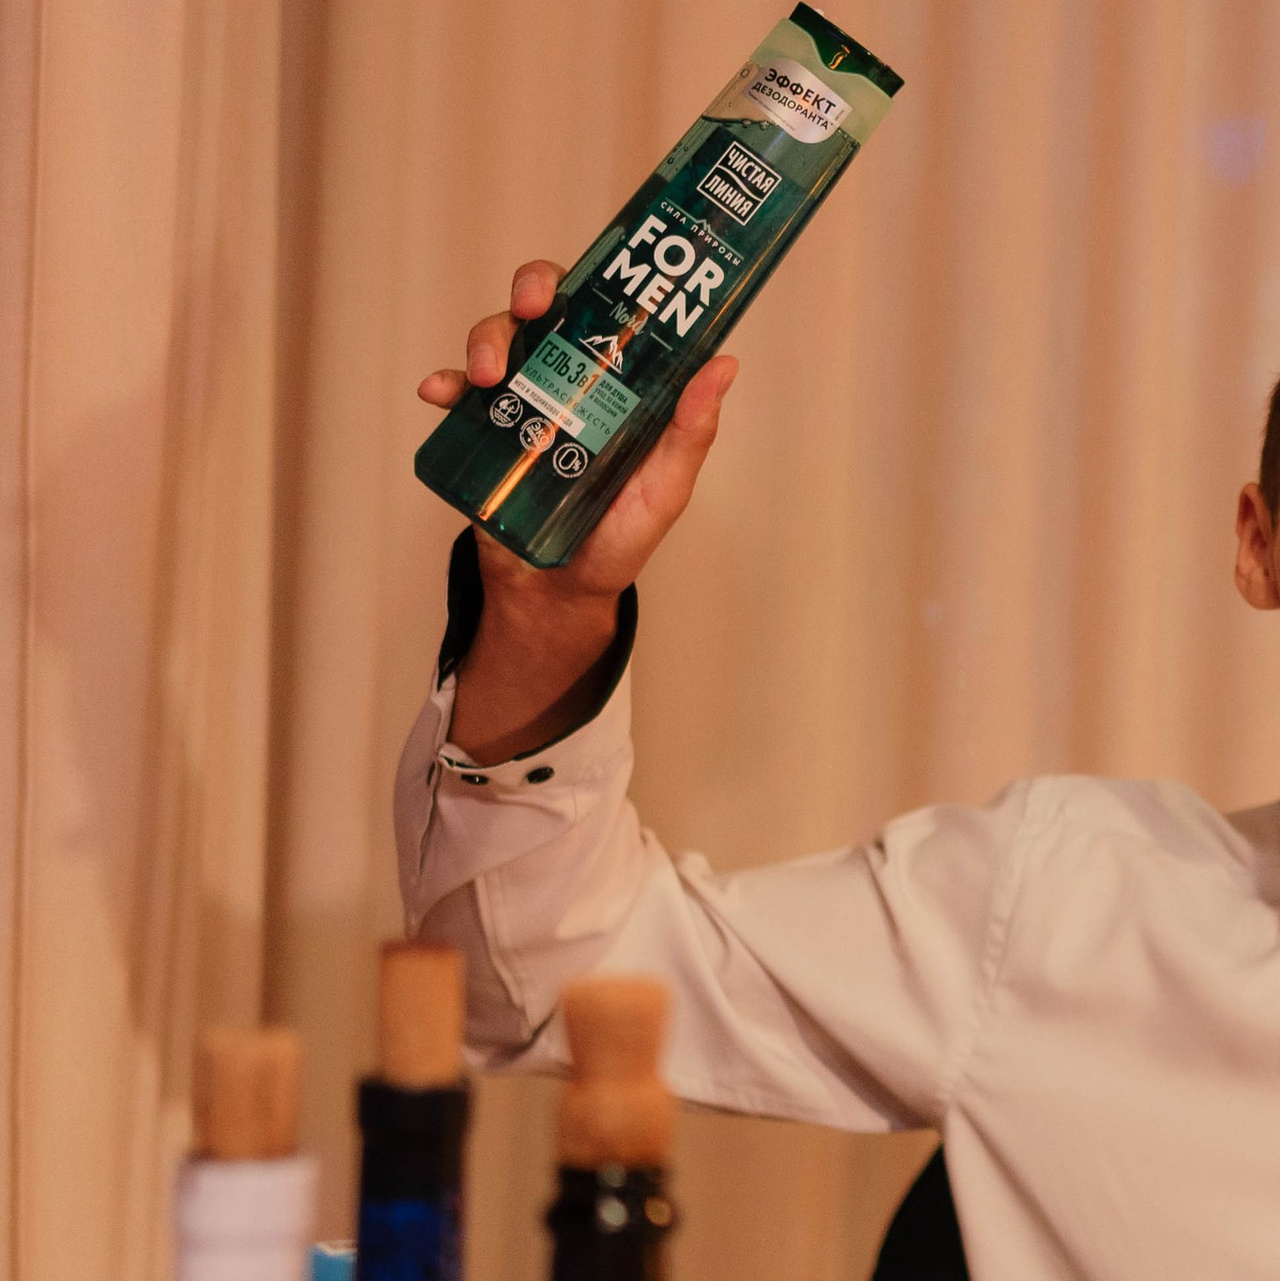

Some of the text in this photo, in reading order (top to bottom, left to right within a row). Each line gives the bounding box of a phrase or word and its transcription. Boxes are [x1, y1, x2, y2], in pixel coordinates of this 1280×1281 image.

[764, 68, 837, 114] ЭФФЕКТ
[728, 148, 775, 193] ЧИСТАЯ
[705, 174, 754, 217] ЛИНИЯ
[660, 201, 741, 266] СИЛА ПРИРОДЫ
[628, 214, 725, 307] FOR
[602, 247, 705, 338] MEN
[609, 301, 649, 335] Nord
[535, 340, 571, 377] ГЕЛЬ
[523, 365, 611, 435] УЛЬТРАСВЕЖЕСТЬ
